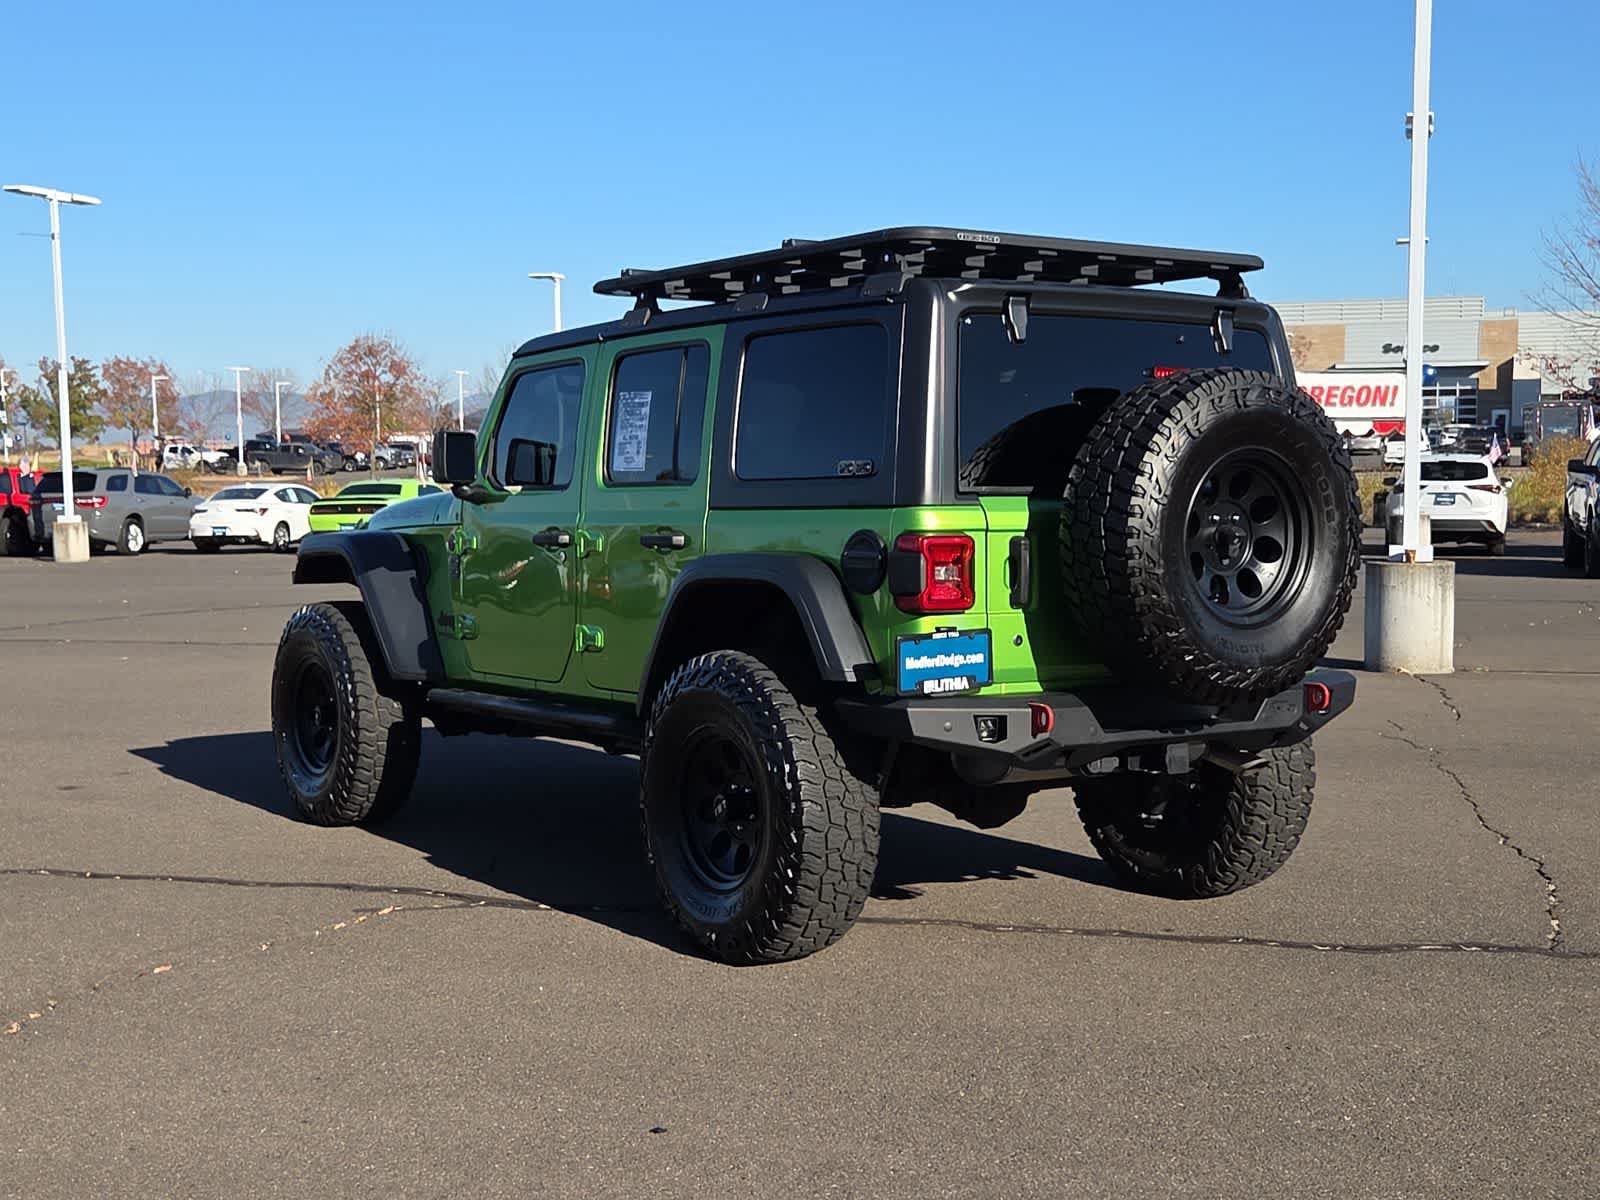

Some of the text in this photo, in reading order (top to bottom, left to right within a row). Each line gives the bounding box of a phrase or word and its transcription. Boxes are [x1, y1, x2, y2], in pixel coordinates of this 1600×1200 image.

[1382, 343, 1439, 354] Sece
[1299, 385, 1399, 407] REGON!
[906, 653, 984, 670] MedfordDodge.com
